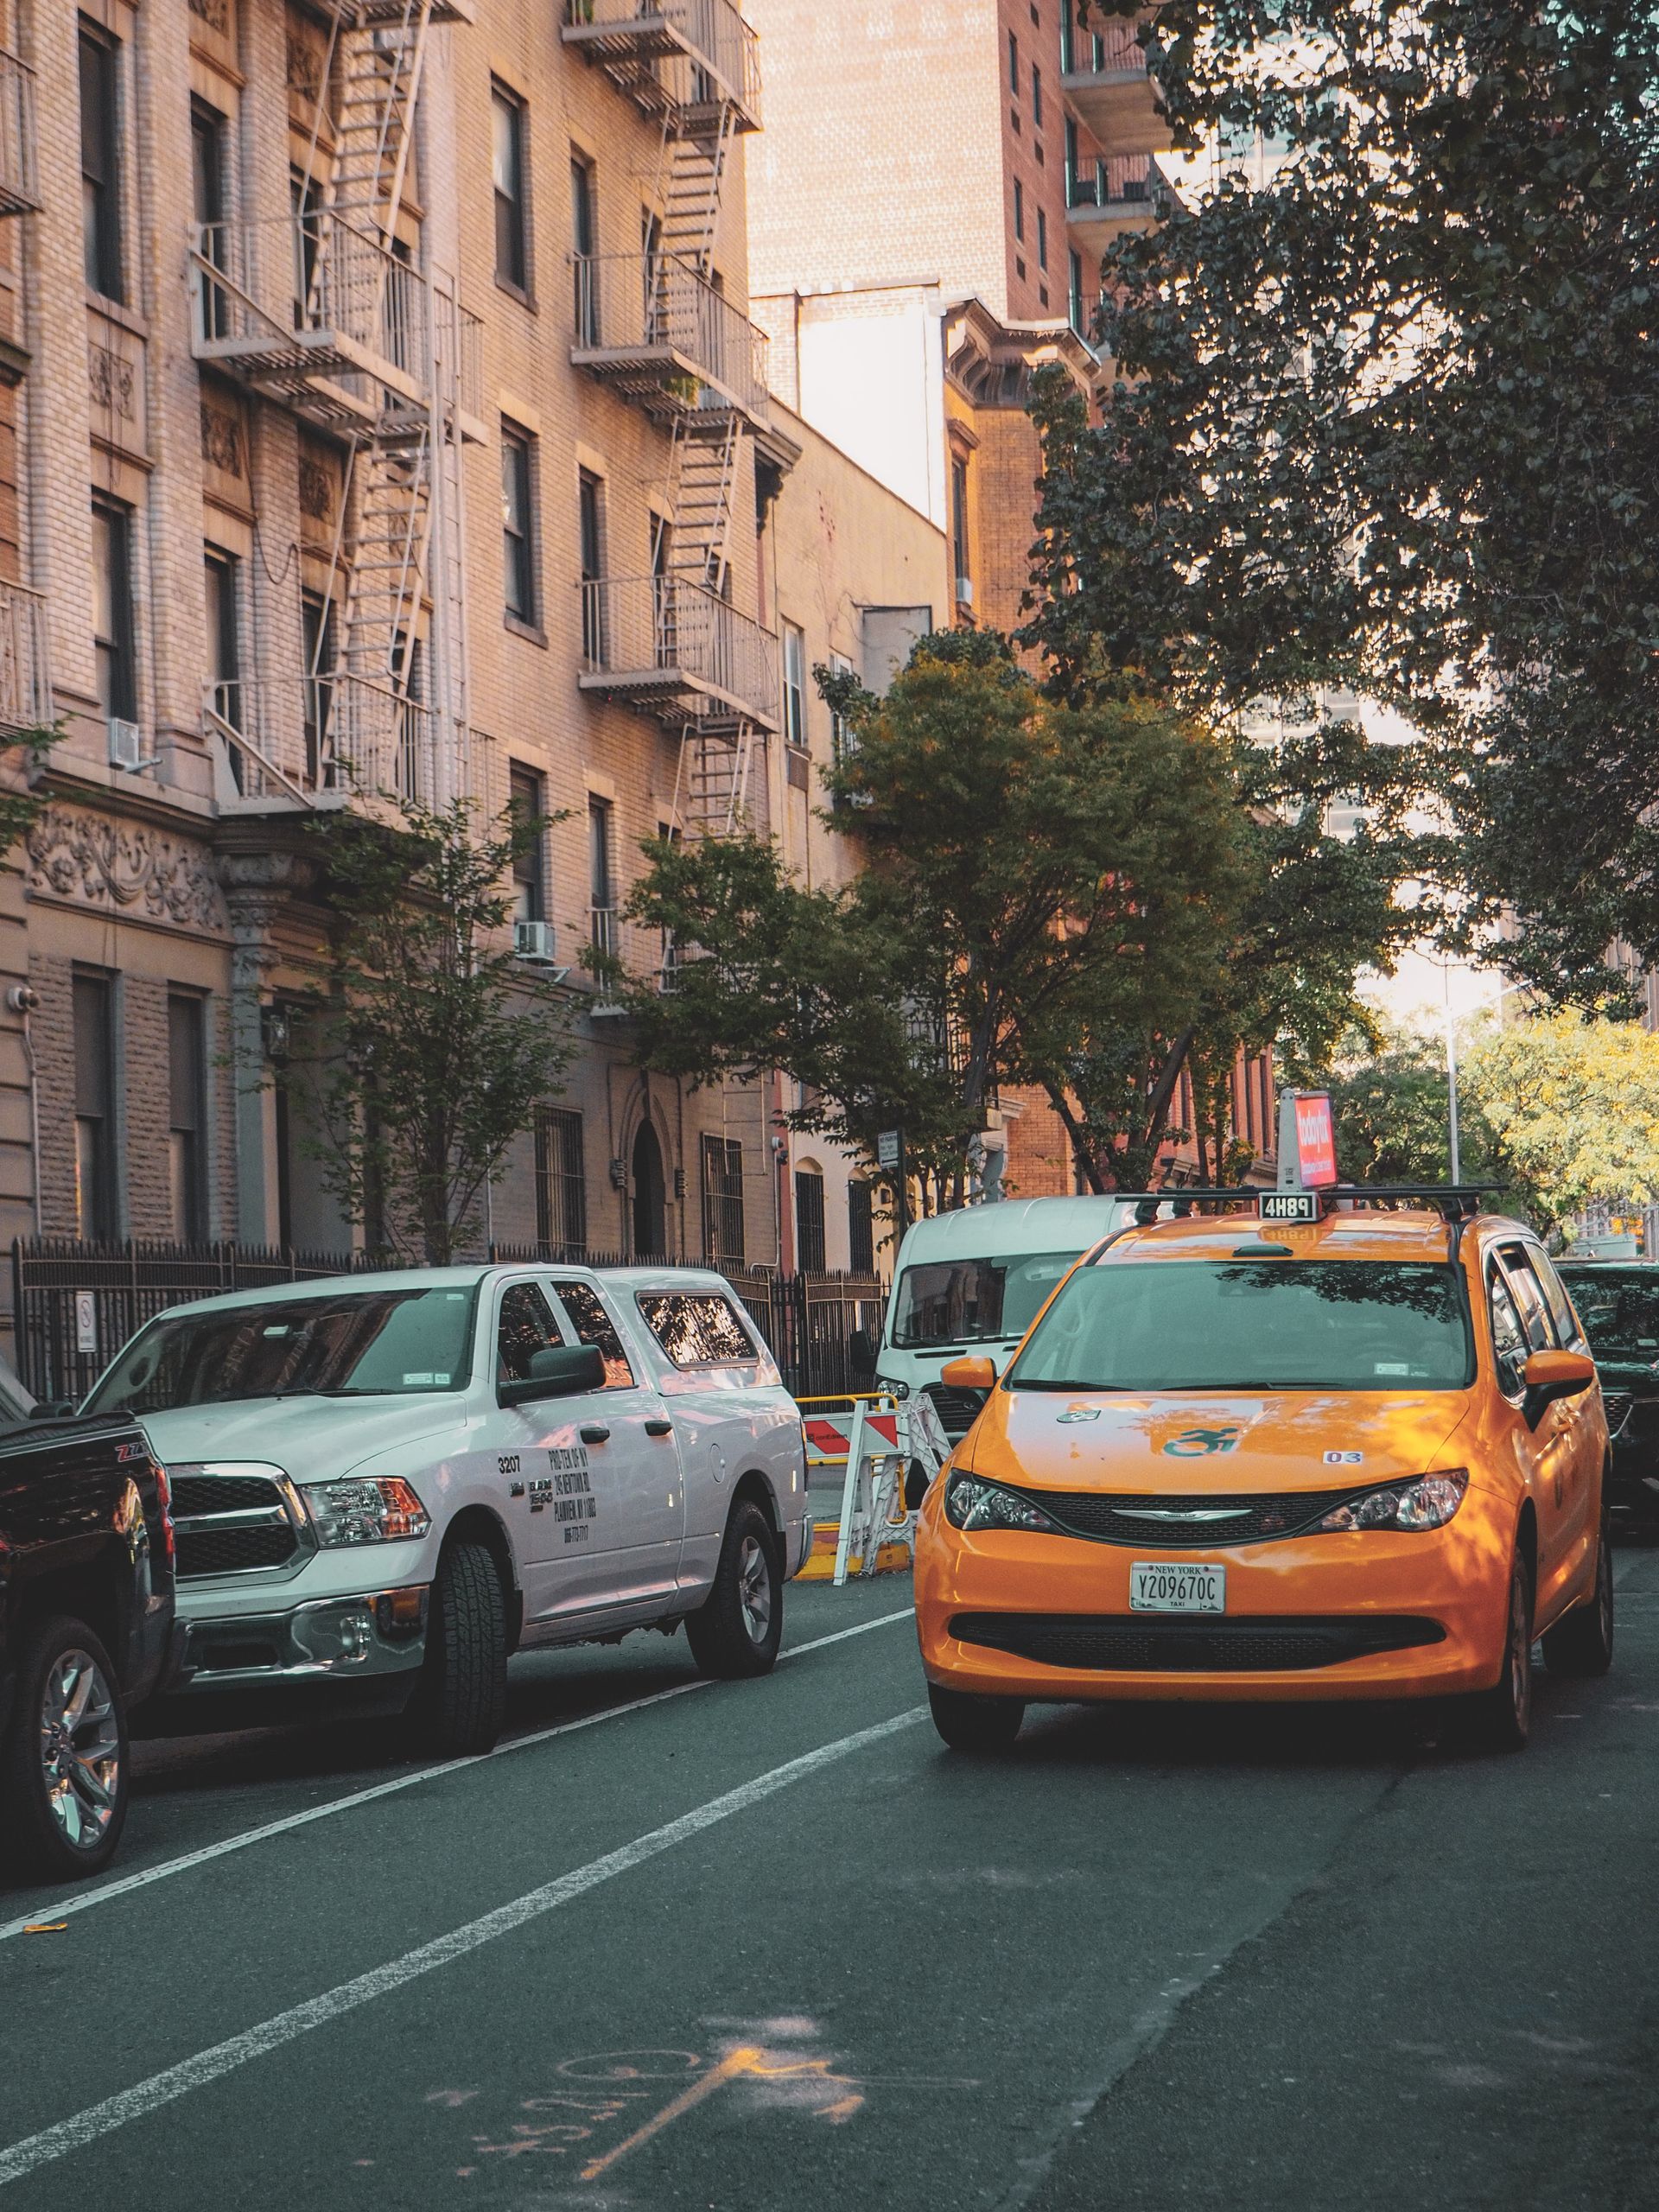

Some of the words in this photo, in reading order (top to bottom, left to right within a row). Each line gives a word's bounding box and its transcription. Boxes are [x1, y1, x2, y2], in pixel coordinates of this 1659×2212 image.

[1265, 1198, 1308, 1217] 4H89
[498, 1455, 520, 1474] 3207
[571, 1447, 580, 1468] OF
[579, 1447, 588, 1467] NY
[529, 1478, 552, 1491] RAM
[530, 1491, 553, 1504] 1500
[576, 1498, 583, 1519] NY
[1154, 1566, 1175, 1574] NEW
[1178, 1566, 1202, 1575] YORK
[1139, 1574, 1215, 1600] Y209670C
